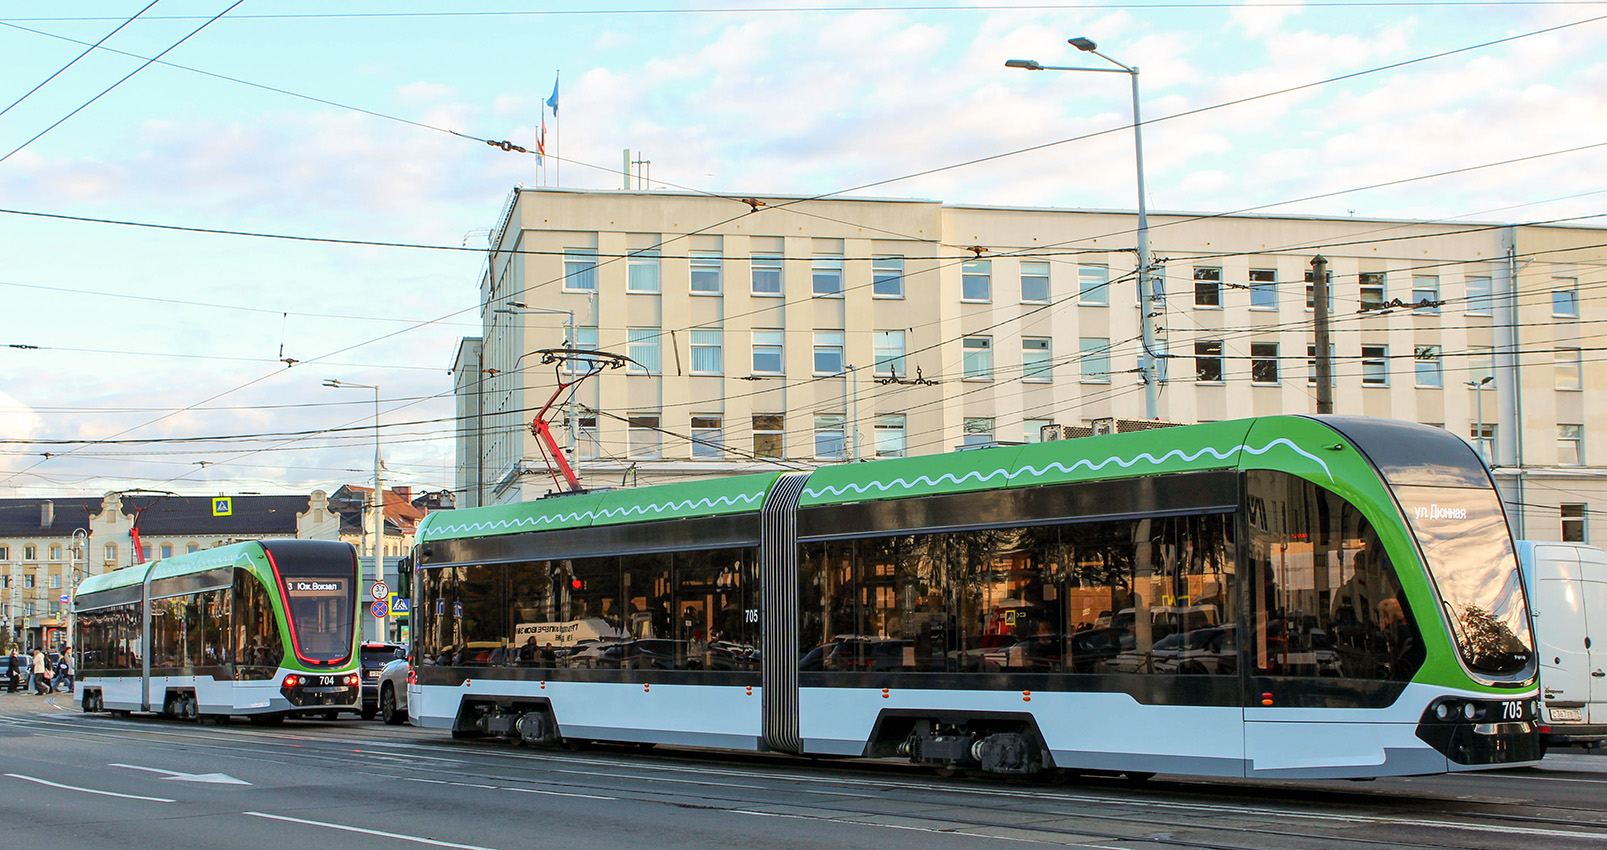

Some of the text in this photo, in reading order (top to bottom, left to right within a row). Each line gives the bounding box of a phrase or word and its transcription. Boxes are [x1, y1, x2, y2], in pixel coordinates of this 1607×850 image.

[1429, 503, 1467, 520] Дюнная
[287, 582, 294, 591] 3
[312, 582, 337, 591] Вокзал
[744, 609, 759, 623] 705
[319, 676, 335, 685] 704
[1501, 701, 1523, 719] 705
